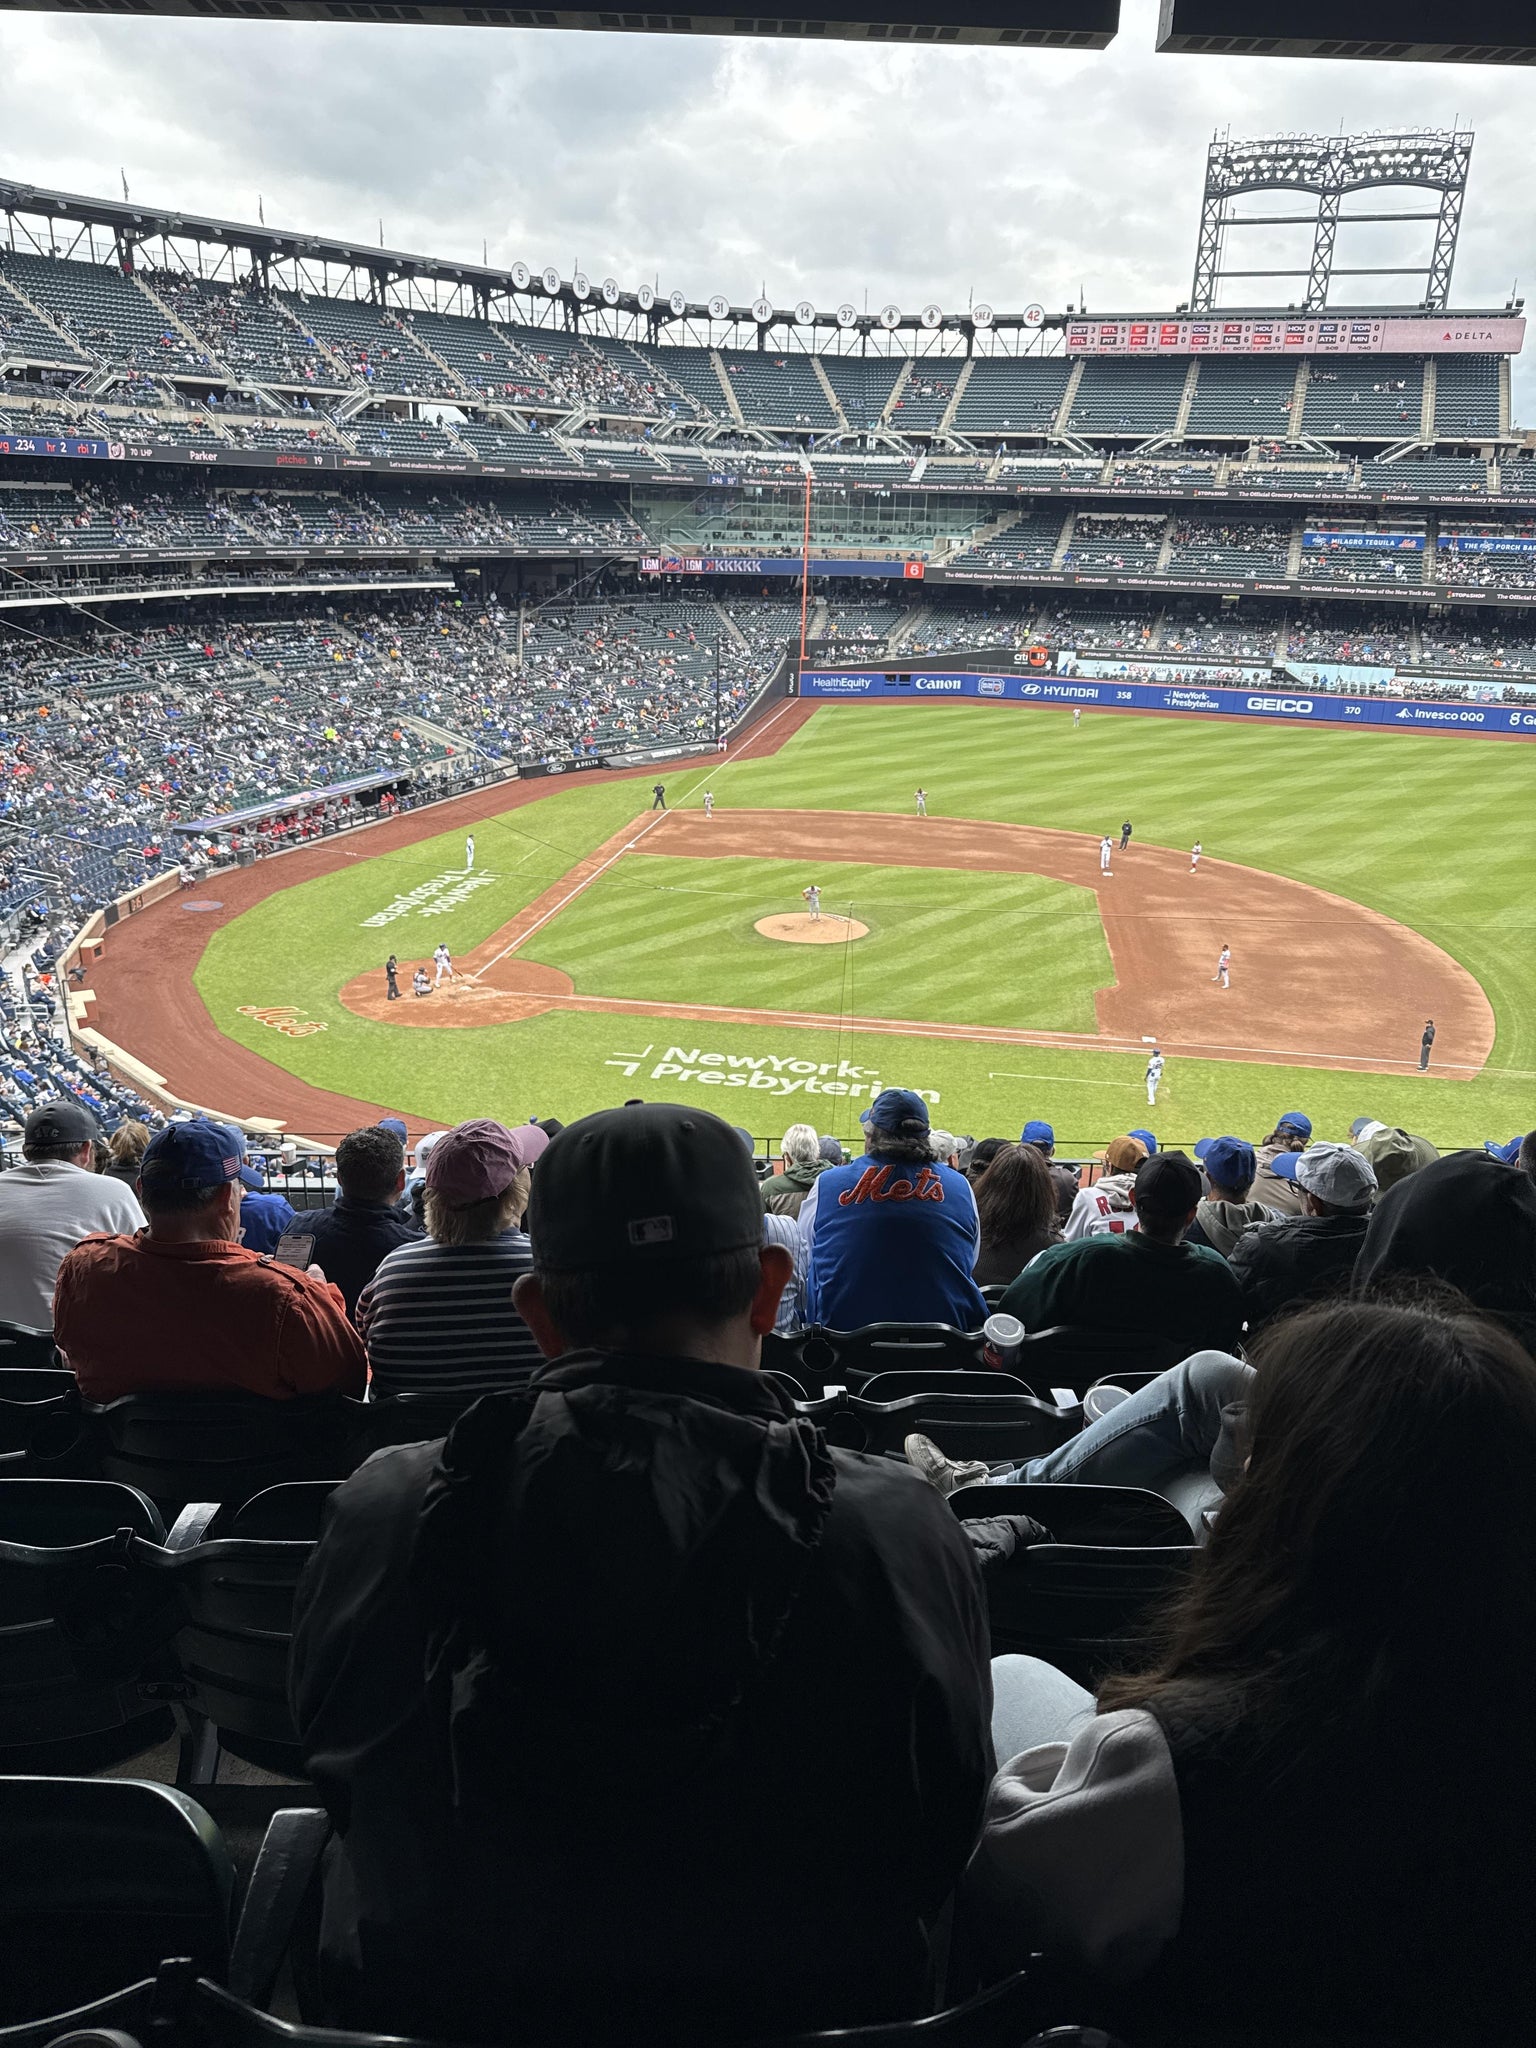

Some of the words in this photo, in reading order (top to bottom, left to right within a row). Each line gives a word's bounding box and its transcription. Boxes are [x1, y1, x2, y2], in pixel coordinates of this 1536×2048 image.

[517, 269, 524, 282] 5
[546, 274, 556, 288] 18
[577, 280, 586, 293] 16
[606, 284, 616, 298] 24
[642, 291, 650, 304] 17
[672, 297, 682, 309] 36
[714, 302, 724, 313] 31
[757, 305, 768, 317] 41
[799, 308, 809, 319] 14
[842, 310, 852, 322] 37
[1027, 310, 1040, 322] 42
[1455, 332, 1493, 340] DELTA
[46, 441, 56, 452] hr
[60, 442, 67, 453] 2
[78, 443, 89, 454] rbi
[92, 444, 98, 455] 7
[130, 448, 138, 456] 70
[141, 448, 153, 457] LHP
[190, 451, 218, 461] Parker
[276, 455, 307, 466] pitches
[314, 456, 323, 465] 19
[1330, 538, 1363, 546] MILAGRO
[642, 558, 659, 570] LGM
[686, 559, 702, 570] LGM
[910, 564, 920, 576] 6
[1037, 652, 1046, 660] 15
[813, 678, 871, 688] HealthEquity
[916, 678, 962, 689] Canon
[1044, 686, 1098, 698] HYUNDAI
[1116, 691, 1132, 700] 358
[1172, 690, 1210, 700] NewYork-
[1172, 699, 1219, 709] Presbyterian
[1246, 697, 1313, 714] GEICO
[1344, 706, 1362, 715] 370
[1415, 708, 1458, 720] Invesco
[1460, 712, 1484, 722] QQQ
[236, 1004, 329, 1038] Mets
[662, 1046, 879, 1078] NewYork-
[650, 1063, 941, 1104] Presbyterin
[838, 1164, 945, 1207] Mets
